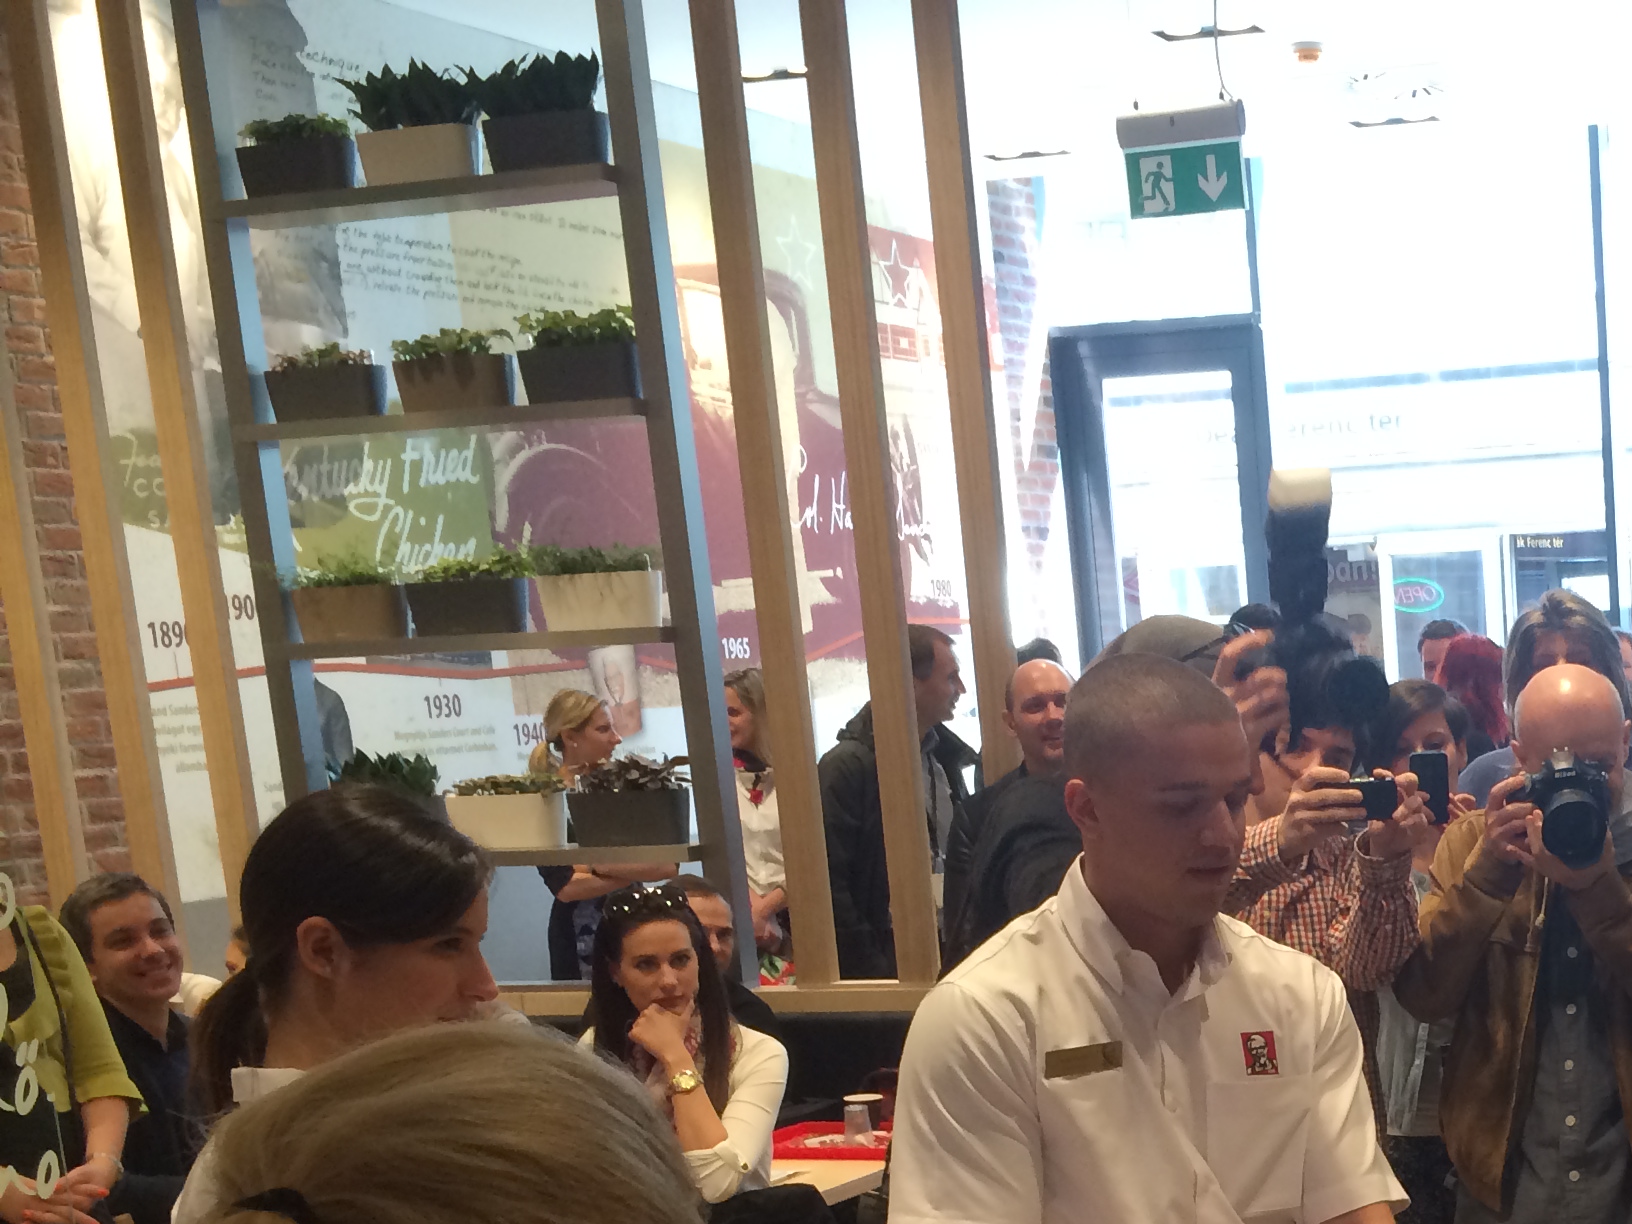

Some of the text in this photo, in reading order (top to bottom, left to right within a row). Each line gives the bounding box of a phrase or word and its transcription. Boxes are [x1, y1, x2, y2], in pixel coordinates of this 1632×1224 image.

[401, 434, 480, 494] Fried
[931, 579, 951, 598] 1980
[147, 621, 188, 649] 189
[721, 637, 751, 659] 1965
[424, 693, 462, 719] 1930
